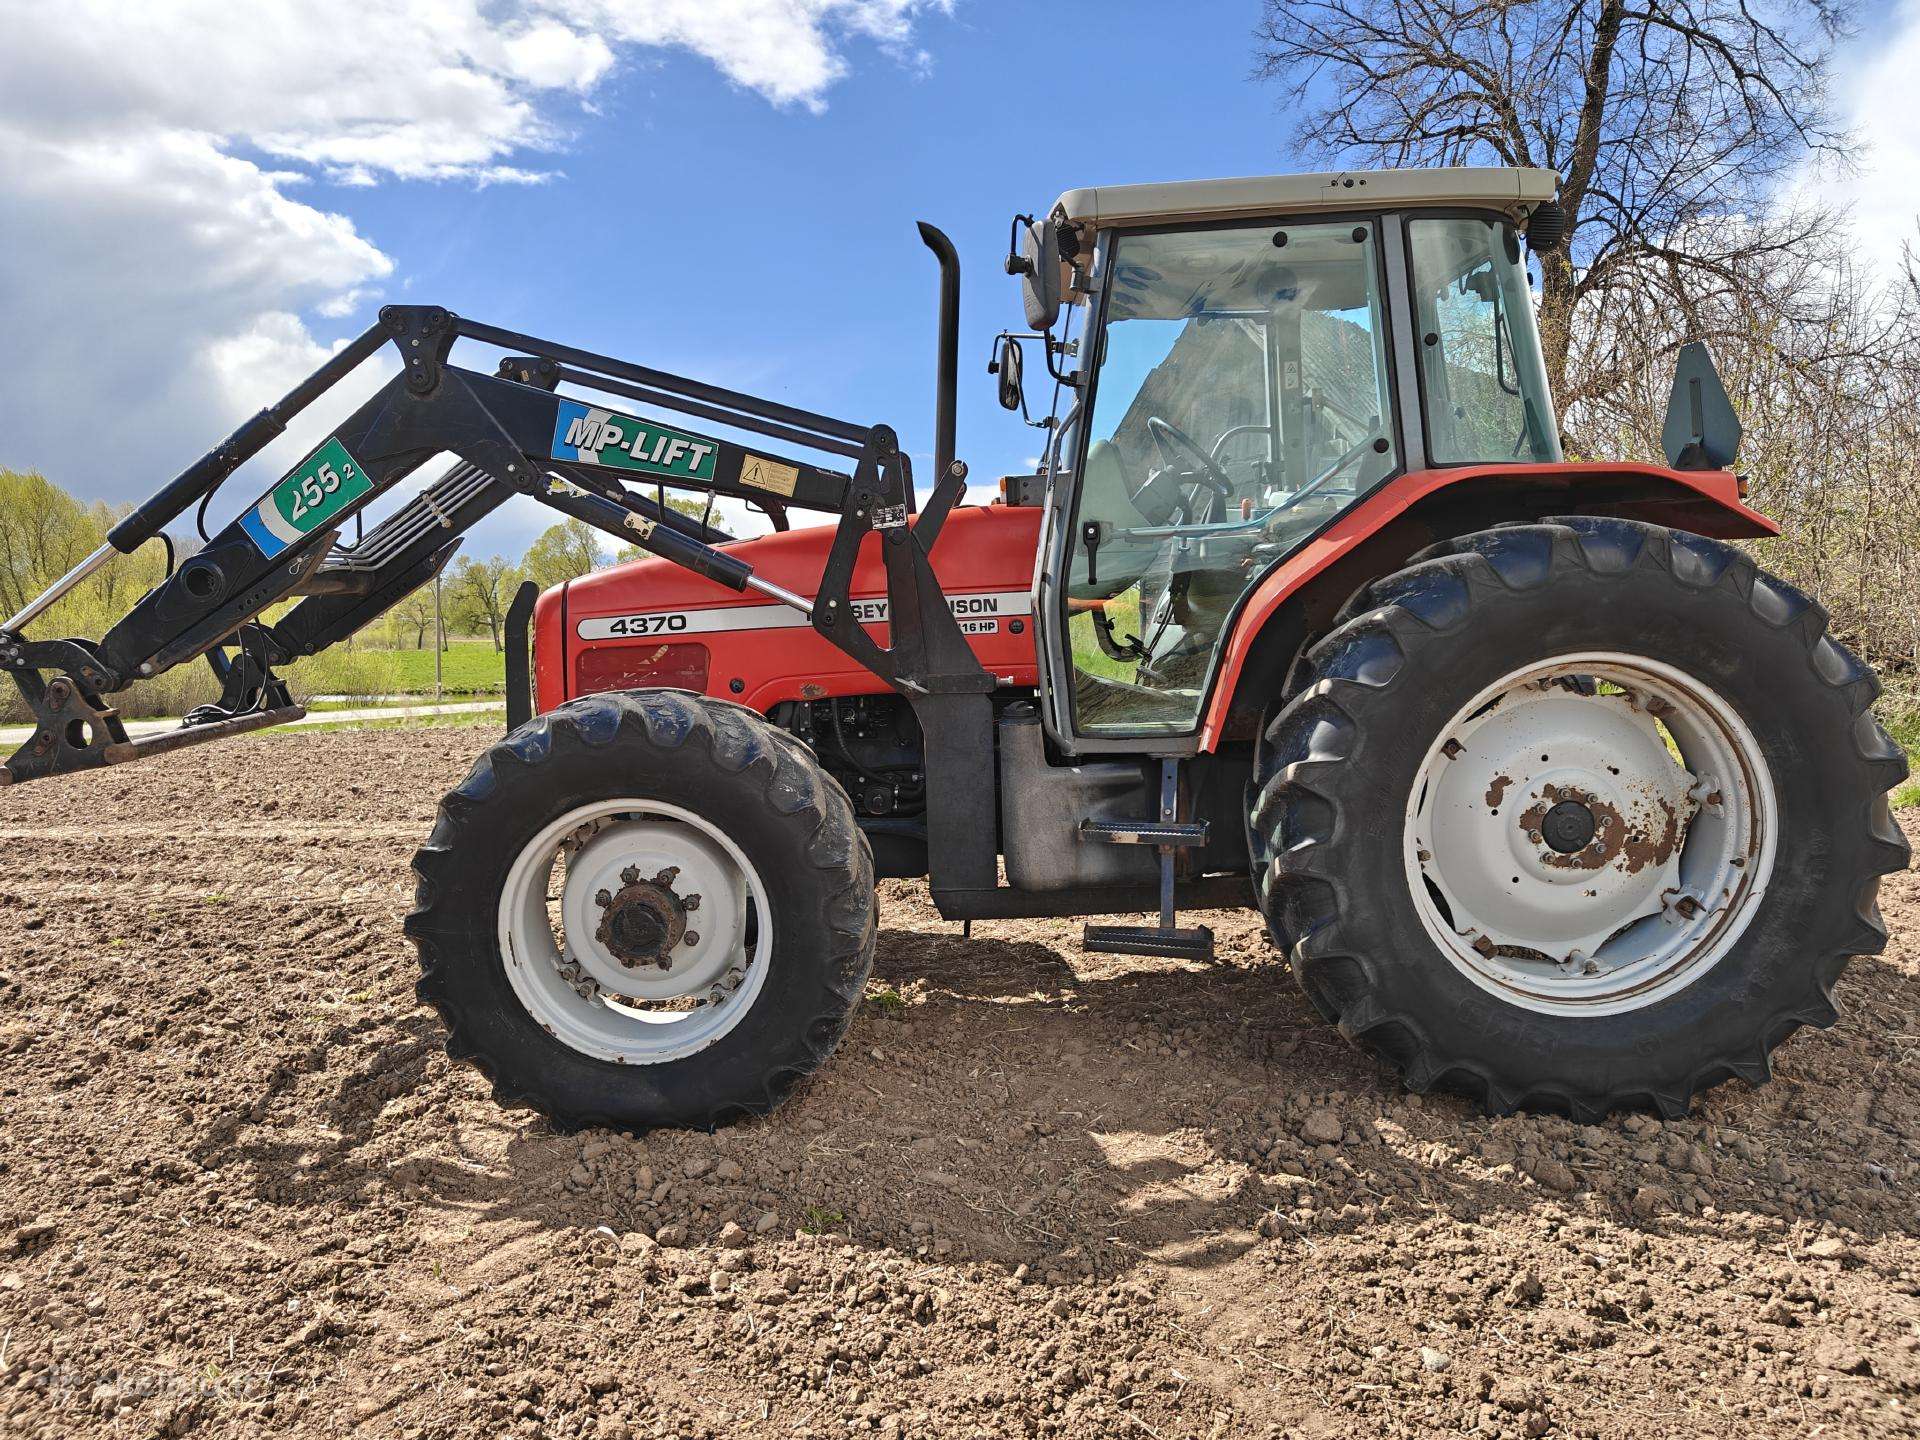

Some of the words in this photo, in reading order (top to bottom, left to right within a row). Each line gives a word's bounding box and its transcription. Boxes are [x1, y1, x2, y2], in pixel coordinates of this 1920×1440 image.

[564, 417, 713, 472] MP-LIFT
[292, 461, 341, 522] 255
[342, 463, 355, 479] 2
[609, 614, 687, 635] 4370
[959, 622, 977, 632] 16
[979, 621, 996, 632] HP
